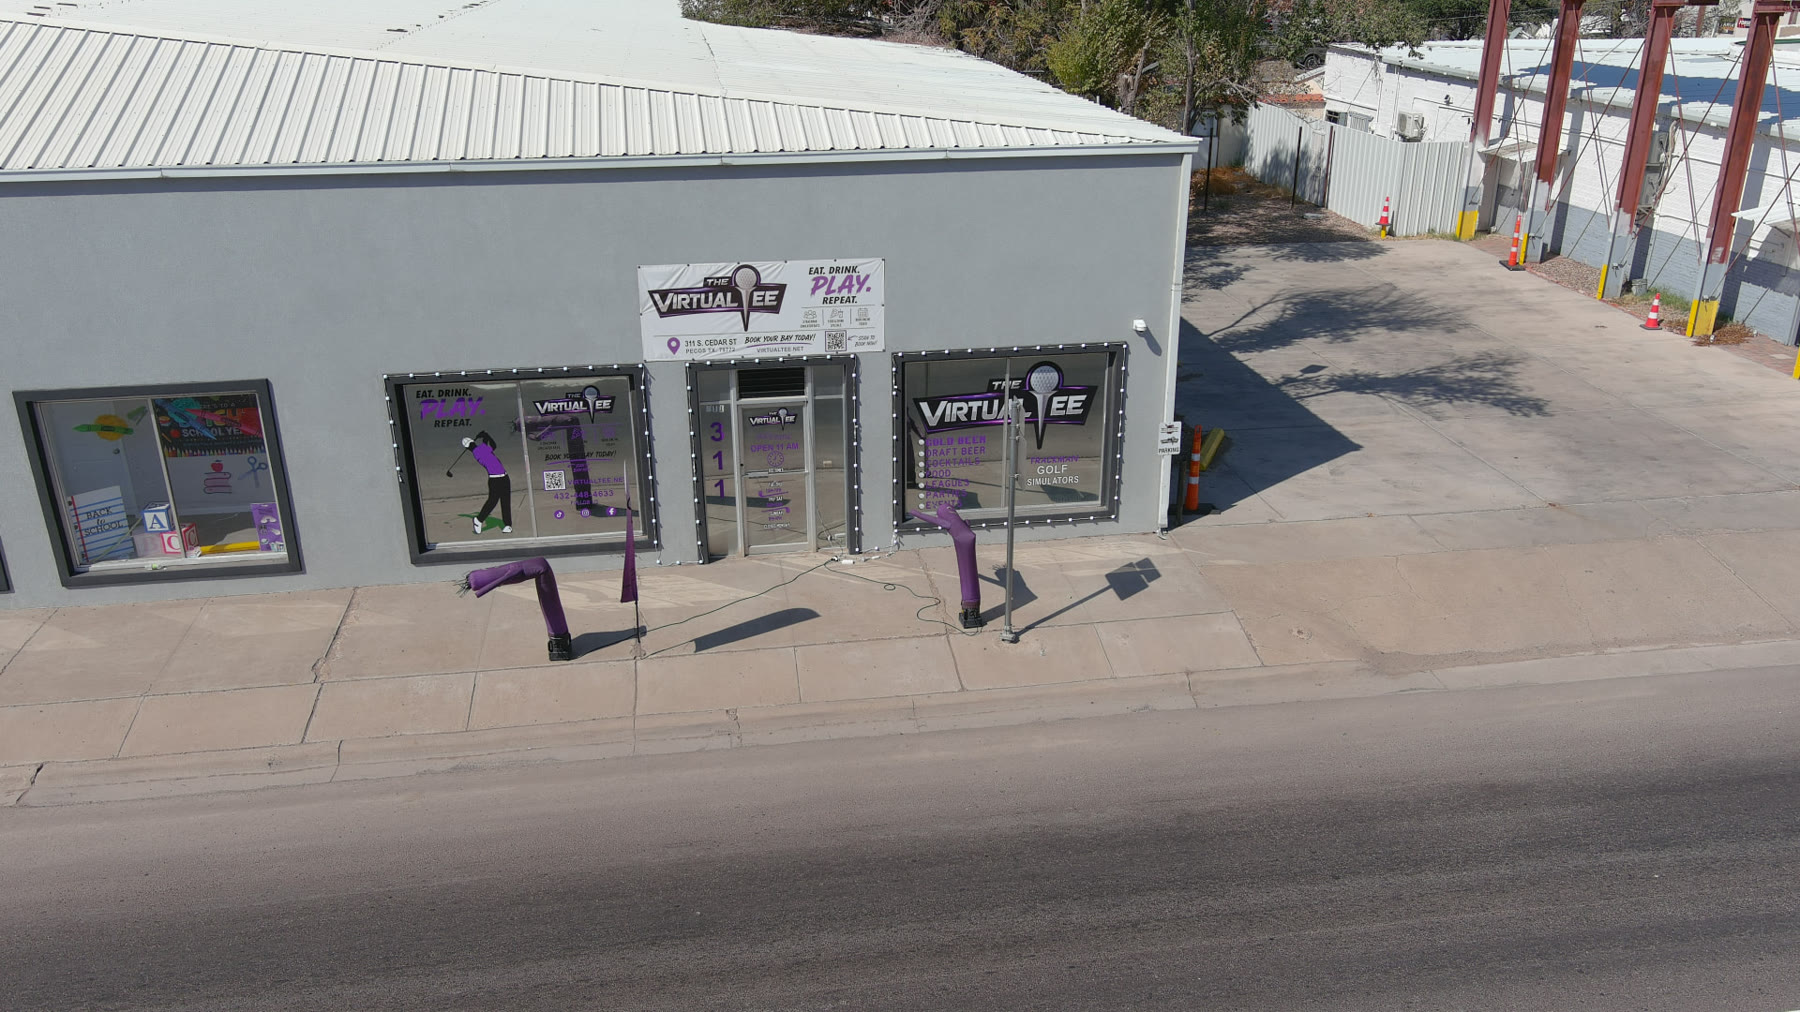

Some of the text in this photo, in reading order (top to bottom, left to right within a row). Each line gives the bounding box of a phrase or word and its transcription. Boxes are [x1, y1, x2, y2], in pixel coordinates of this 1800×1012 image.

[808, 265, 860, 275] EAT. DRINK.
[706, 278, 729, 286] THE
[811, 274, 872, 297] PLAY.
[652, 291, 738, 313] VIRTUAL
[822, 296, 858, 305] REPEAT.
[744, 333, 817, 345] BOOK YOUR BAY TODAY!
[416, 388, 472, 399] EAT. DRINK.
[420, 396, 486, 420] PLAY.
[535, 401, 588, 414] VIRTUAL
[434, 419, 472, 428] REPEAT.
[749, 416, 780, 425] VIRTUAL
[182, 427, 224, 438] SCHOL
[750, 444, 774, 453] OPEN
[786, 442, 799, 450] AM
[926, 446, 986, 458] DRAFT BEER
[544, 453, 561, 462] BOOK
[595, 450, 617, 458] TODAY!
[926, 457, 981, 468] COCKTAILS
[926, 469, 951, 479] FOOD
[1037, 464, 1068, 475] GOLF
[567, 476, 626, 486] VIRTUALTEE.NE
[926, 478, 970, 489] LEAGUES
[1026, 475, 1079, 486] SIMULATORS
[553, 490, 614, 500] 432-448-4633
[926, 488, 968, 499] PARTIES
[86, 507, 113, 519] BACK
[96, 518, 106, 526] to
[149, 514, 167, 529] A
[84, 521, 124, 537] SCHOOL
[167, 536, 181, 551] C
